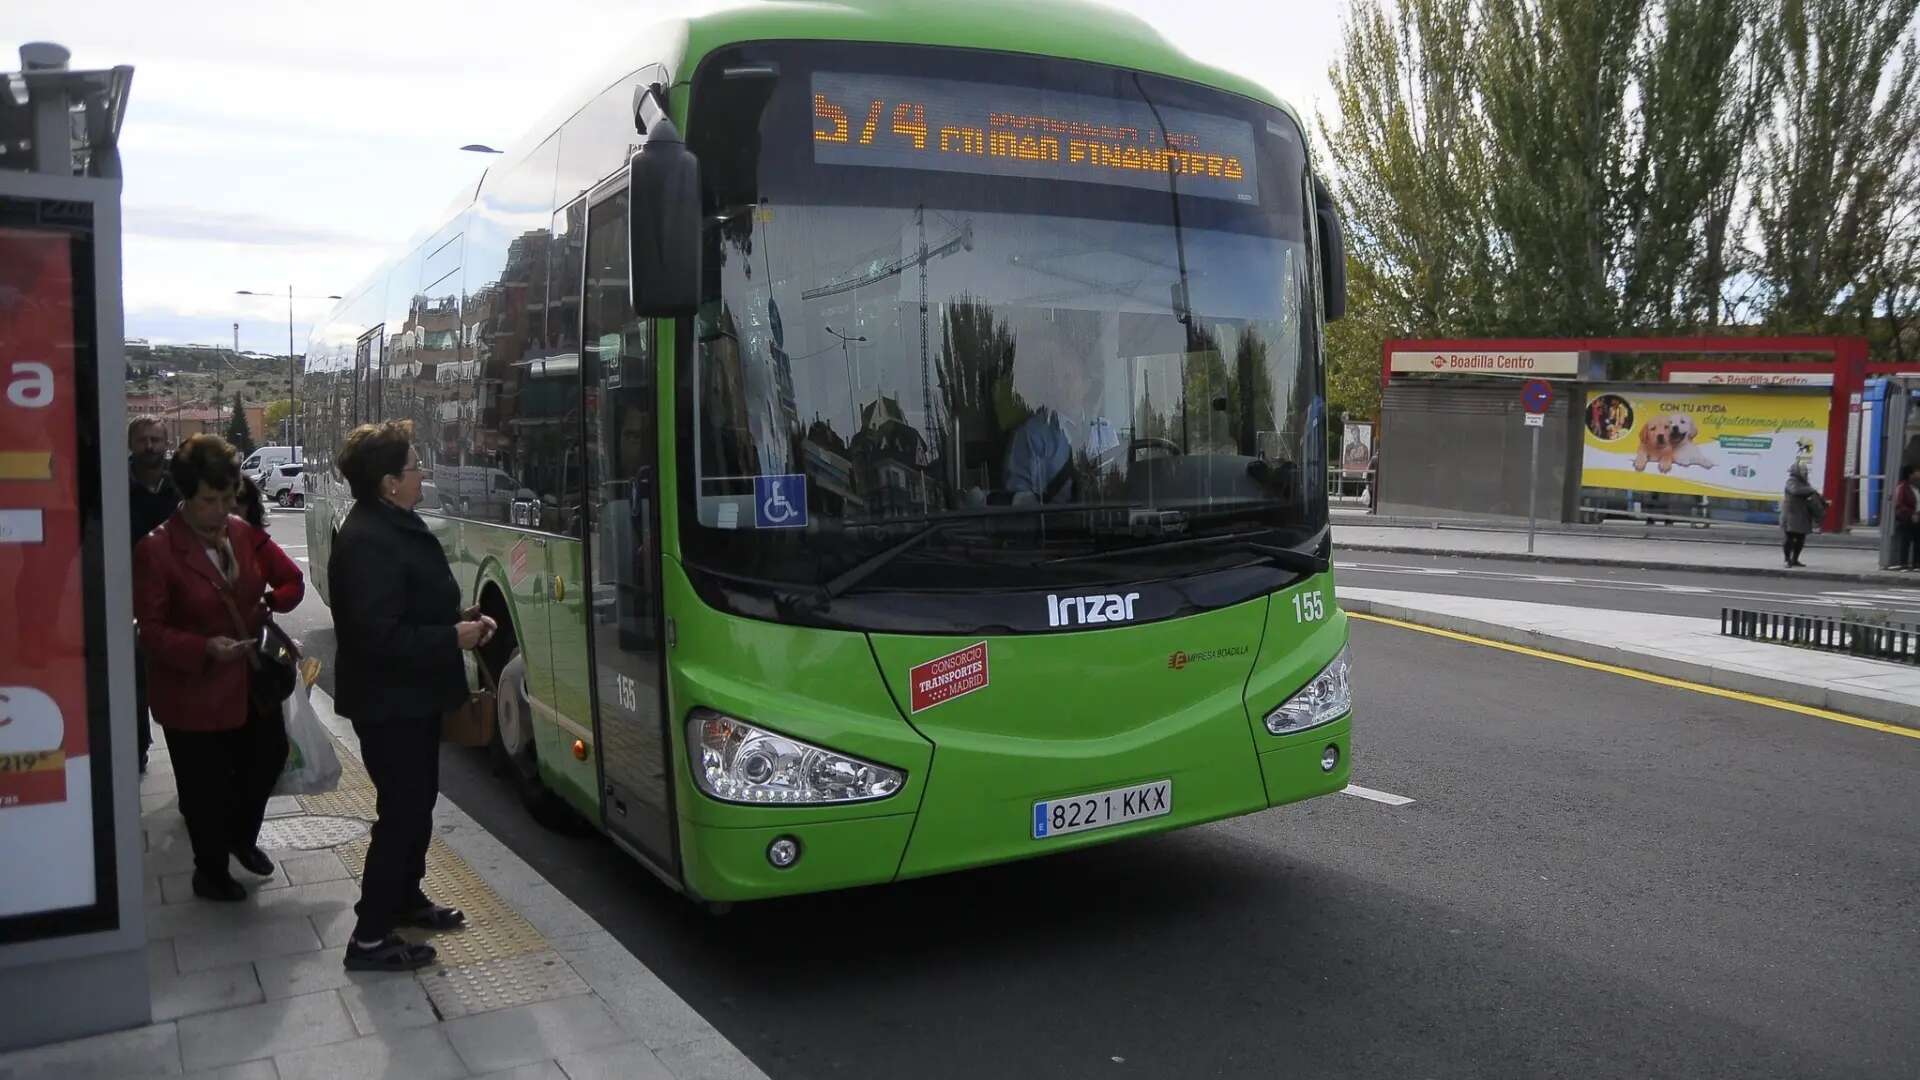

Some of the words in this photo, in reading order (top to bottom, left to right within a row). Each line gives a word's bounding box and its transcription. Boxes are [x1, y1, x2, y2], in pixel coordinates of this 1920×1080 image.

[1450, 354, 1494, 369] Boadilla
[1497, 355, 1535, 369] Centro
[1660, 403, 1680, 412] CON
[1047, 593, 1140, 627] Irizar
[1292, 591, 1324, 624] 155
[920, 661, 982, 693] TRANSPORTES
[931, 648, 982, 675] CONSORCIO
[617, 673, 636, 712] 155
[949, 673, 983, 696] MADRID
[1052, 796, 1111, 830] 8221
[1123, 784, 1166, 817] KKX
